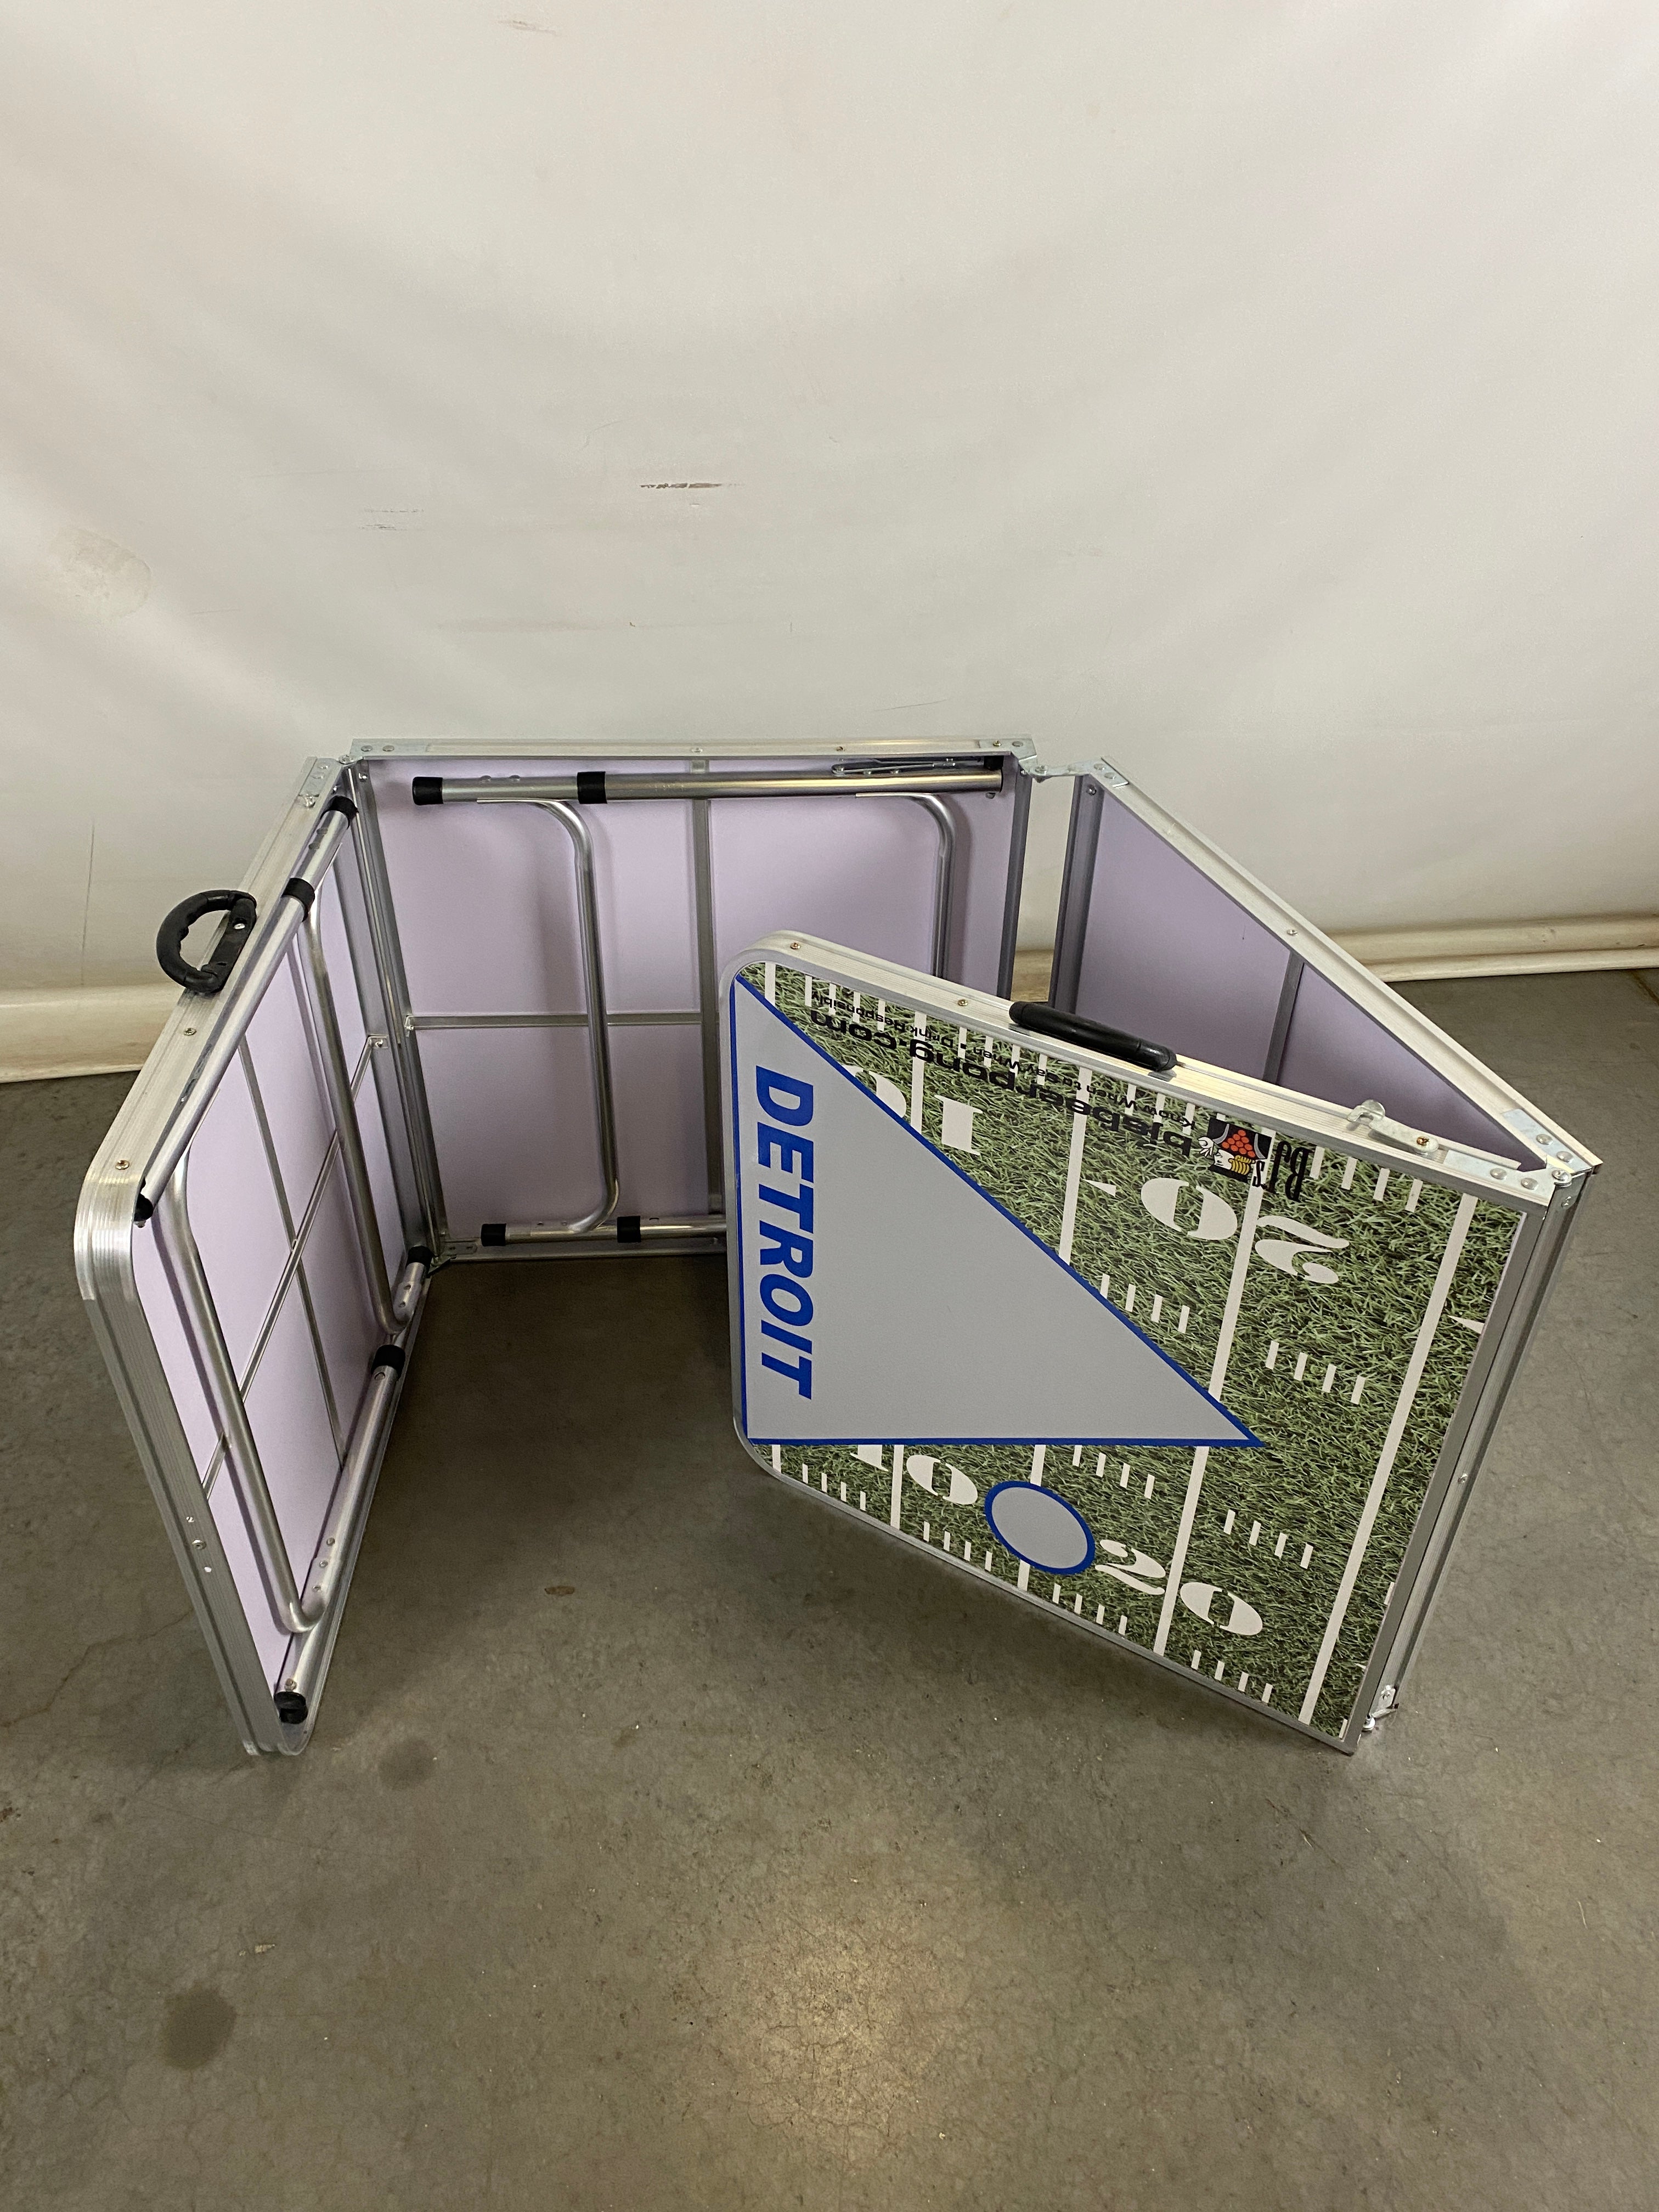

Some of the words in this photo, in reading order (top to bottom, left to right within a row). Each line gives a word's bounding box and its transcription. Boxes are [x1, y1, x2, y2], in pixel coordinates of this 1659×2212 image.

[812, 992, 907, 1033] Responsibly
[910, 1025, 954, 1048] Drink
[973, 1046, 1021, 1070] When
[810, 1010, 1193, 1157] bjsbeerpong.com
[1027, 1064, 1062, 1084] Say
[1063, 1077, 1082, 1091] to
[1087, 1085, 1138, 1111] When
[1143, 1104, 1196, 1131] Know
[755, 1065, 814, 1400] DETROIT
[1141, 1177, 1350, 1284] 20
[1096, 1539, 1263, 1635] 20
